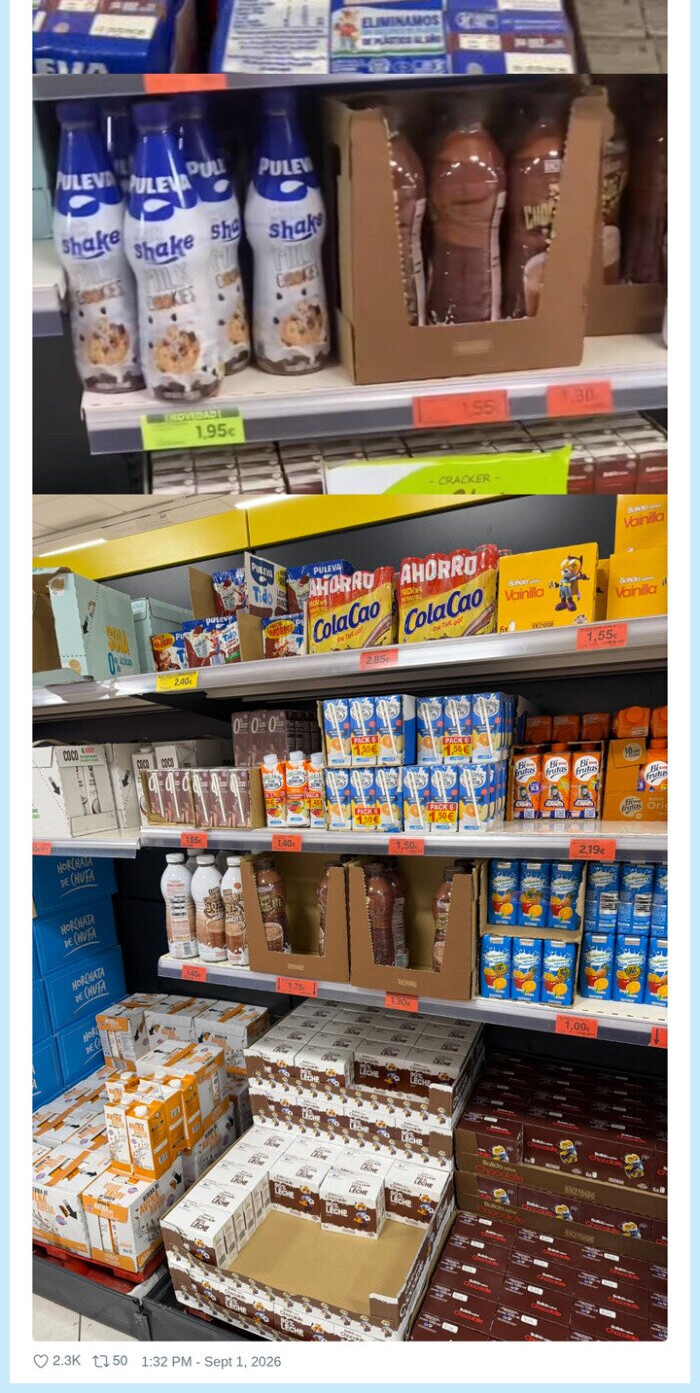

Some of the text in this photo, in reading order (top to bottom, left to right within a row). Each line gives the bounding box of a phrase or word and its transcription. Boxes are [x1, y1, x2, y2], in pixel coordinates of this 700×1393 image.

[56, 171, 115, 191] PULEVA
[129, 174, 192, 195] PULEVA
[269, 211, 324, 241] shake
[62, 228, 121, 258] shake
[134, 233, 195, 263] shake
[438, 473, 491, 486] CRACKER
[623, 510, 664, 528] Vainilla
[313, 564, 342, 575] PULEVA
[400, 554, 478, 586] AHORRO
[308, 571, 375, 598] AHORRO
[616, 583, 658, 599] Vainilla
[504, 586, 545, 602] Vainilla
[403, 588, 483, 635] ColaCao
[313, 601, 380, 644] ColaCao
[354, 736, 371, 744] PACK
[445, 736, 463, 744] PACK
[63, 749, 79, 761] COCO
[353, 745, 379, 757] 1,50€
[443, 744, 471, 757] 1,50€
[136, 759, 149, 770] COCO
[161, 756, 175, 769] COCO
[515, 768, 536, 778] frutas
[546, 766, 567, 777] frutas
[576, 765, 598, 776] frutas
[357, 808, 374, 816] PACK
[430, 803, 449, 811] PACK
[356, 815, 381, 826] 1,50€
[428, 812, 455, 824] 1,50€
[57, 857, 93, 875] HORCHATA
[60, 869, 95, 888] DE CHUFA
[60, 913, 95, 935] HORCHATA
[64, 927, 97, 949] DE CHUFA
[72, 967, 105, 991] HORCHATA
[75, 979, 107, 1004] DE CHUFA
[527, 1141, 558, 1153] Chocolate
[589, 1155, 623, 1168] Chocolate
[475, 1164, 525, 1183] Chocolate
[275, 1188, 295, 1200] LECHE
[326, 1206, 348, 1218] LECHE
[281, 1324, 304, 1338] LECHE
